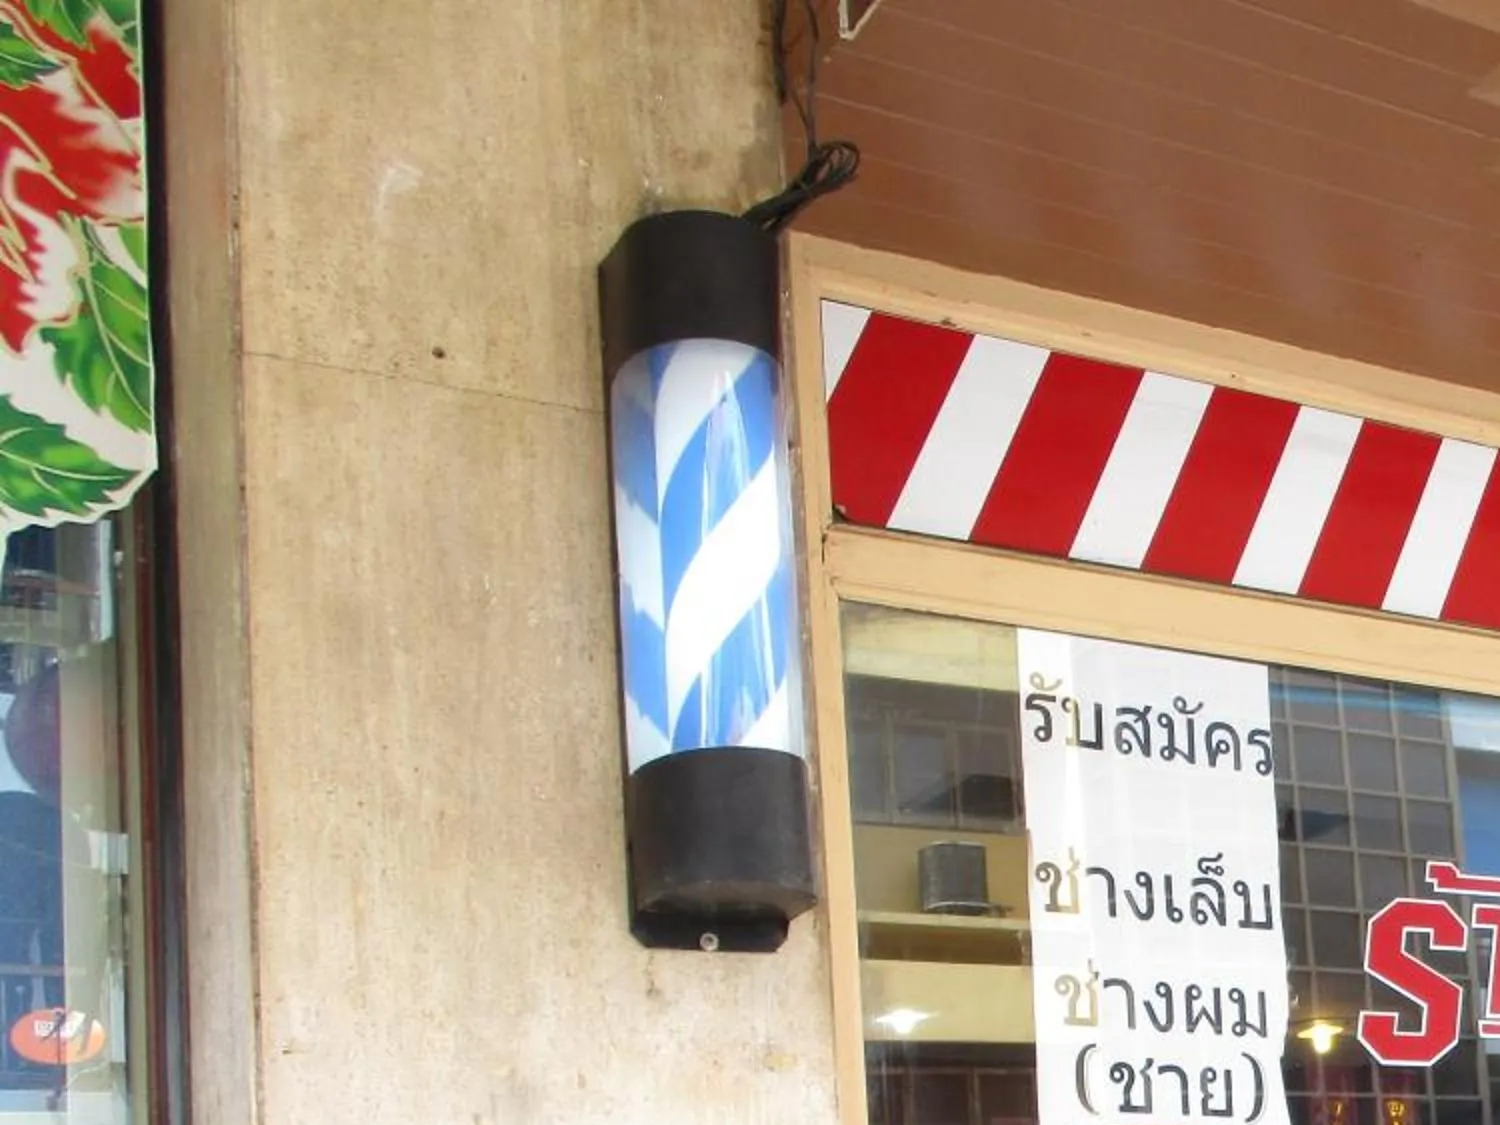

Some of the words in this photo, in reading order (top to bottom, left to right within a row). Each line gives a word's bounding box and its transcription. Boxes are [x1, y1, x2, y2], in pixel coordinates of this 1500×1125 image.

[1024, 670, 1274, 777] รับสมัคร
[1035, 847, 1274, 931] ช่างเล็บ
[1054, 958, 1268, 1038] ช่างผม
[1075, 1042, 1266, 1123] (ชาย)
